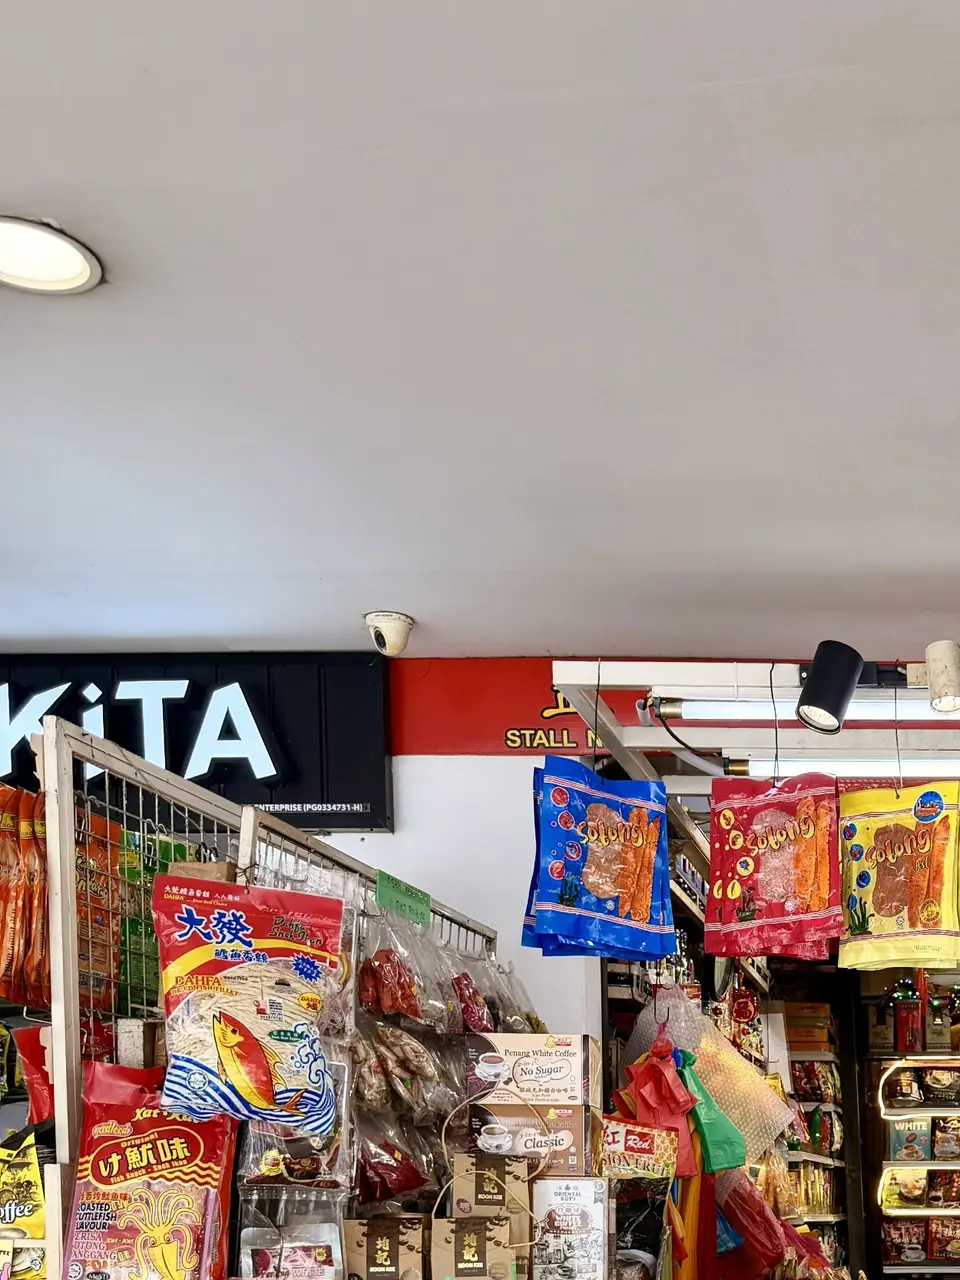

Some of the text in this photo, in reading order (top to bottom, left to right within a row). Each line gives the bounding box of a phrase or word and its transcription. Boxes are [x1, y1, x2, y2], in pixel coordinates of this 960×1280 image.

[506, 729, 577, 748] STALL
[175, 975, 223, 987] DAHFA
[504, 1049, 577, 1058] Penang White Coffee
[520, 1065, 564, 1077] No Sugar
[894, 1121, 928, 1132] WHITE
[524, 1137, 564, 1149] Classic
[627, 1135, 652, 1150] Red
